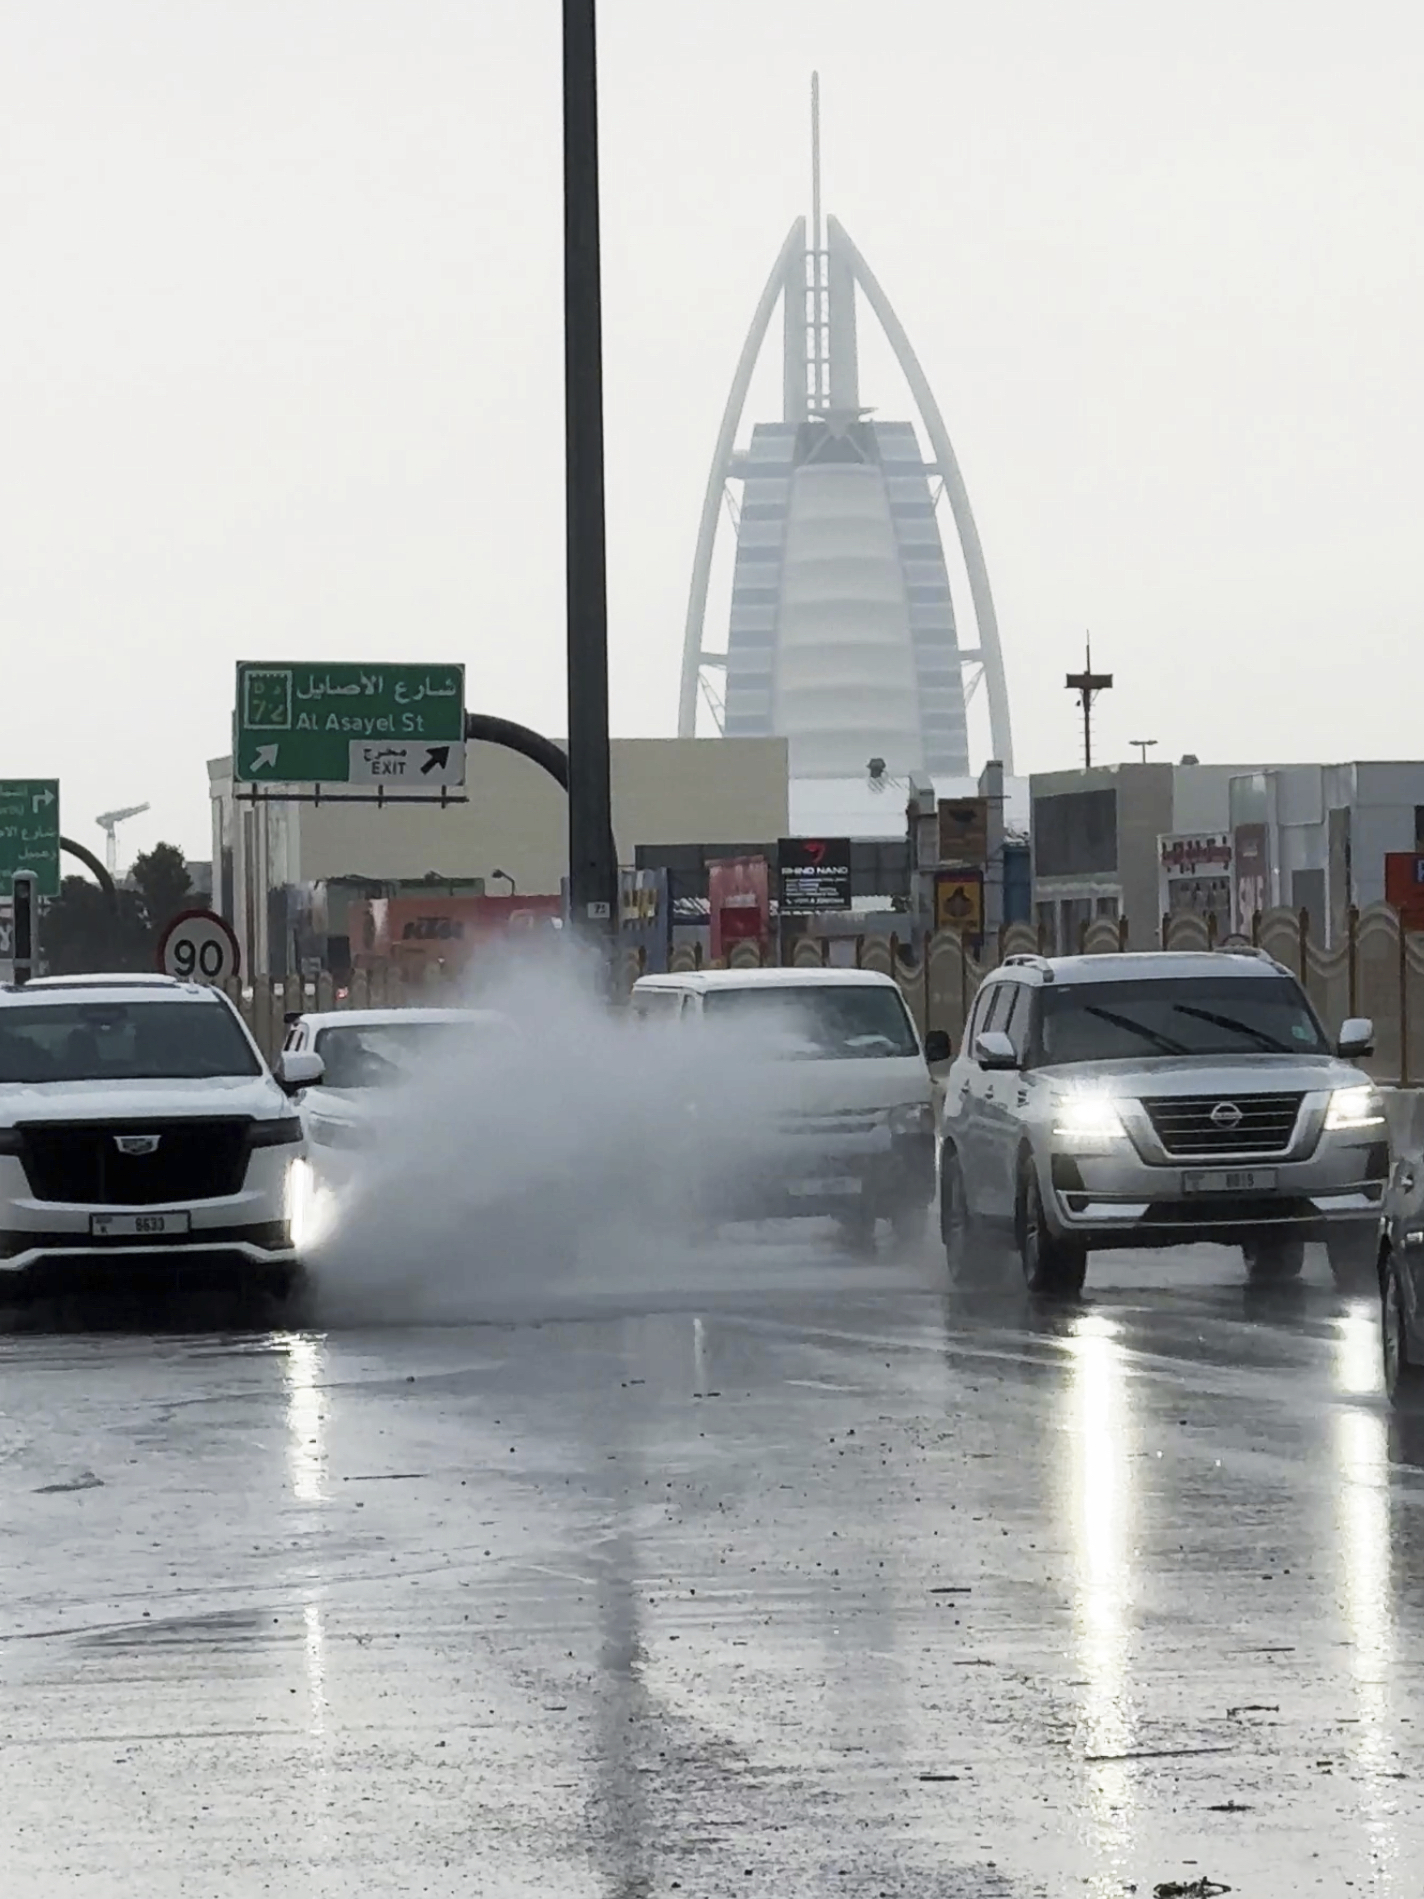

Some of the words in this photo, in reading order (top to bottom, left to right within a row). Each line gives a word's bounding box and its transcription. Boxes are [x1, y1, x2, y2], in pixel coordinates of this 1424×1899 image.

[394, 675, 456, 704] شارع
[296, 712, 319, 731] Al
[325, 712, 396, 735] Asayel
[402, 712, 425, 732] St
[371, 760, 406, 775] EXIT
[174, 939, 223, 977] 90
